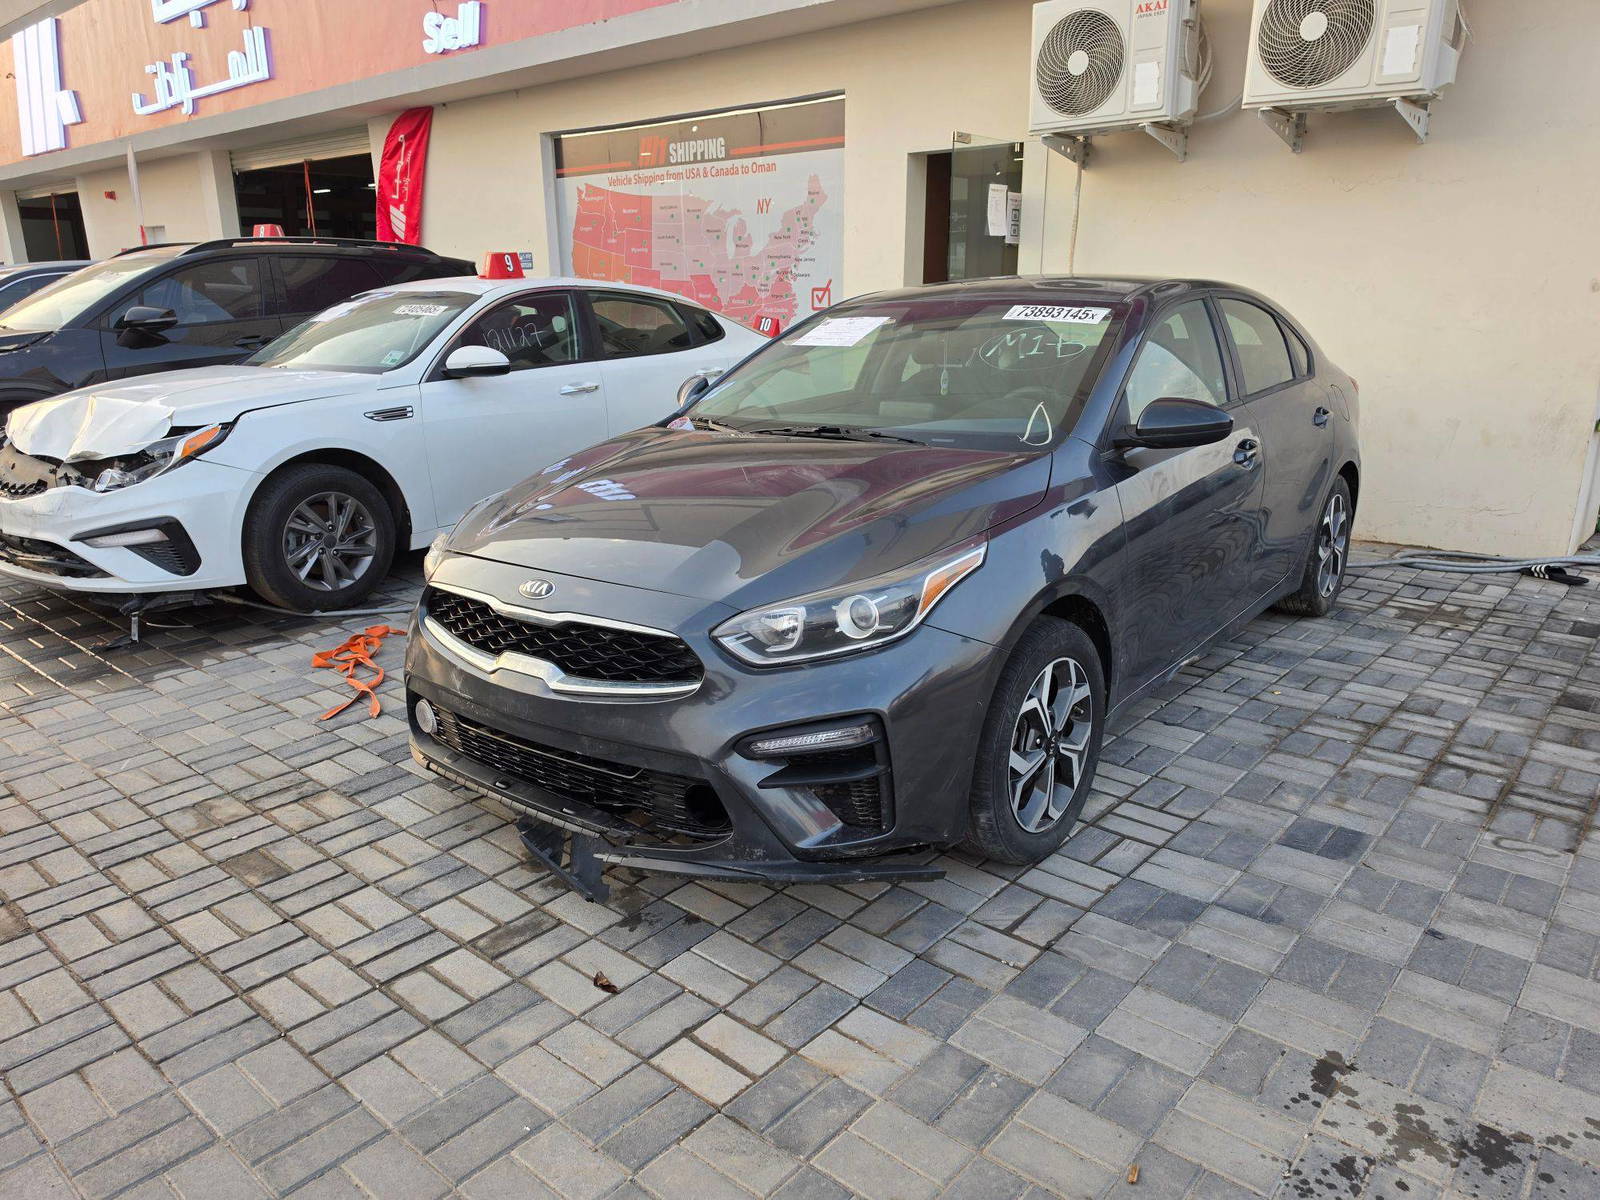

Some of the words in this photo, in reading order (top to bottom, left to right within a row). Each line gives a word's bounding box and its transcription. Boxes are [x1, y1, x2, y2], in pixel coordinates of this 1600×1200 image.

[1136, 0, 1168, 14] AKAI
[422, 0, 481, 54] Sell
[669, 137, 726, 164] SHIPPING
[607, 174, 632, 187] Vehicle
[633, 171, 665, 187] Shipping
[665, 169, 684, 181] from
[685, 166, 701, 180] USA
[703, 167, 709, 178] &
[710, 163, 739, 177] Canada
[741, 165, 749, 174] to
[751, 162, 776, 174] Oman
[757, 198, 772, 214] NY
[504, 254, 514, 272] 9
[760, 317, 772, 332] 10
[519, 580, 550, 596] KIA
